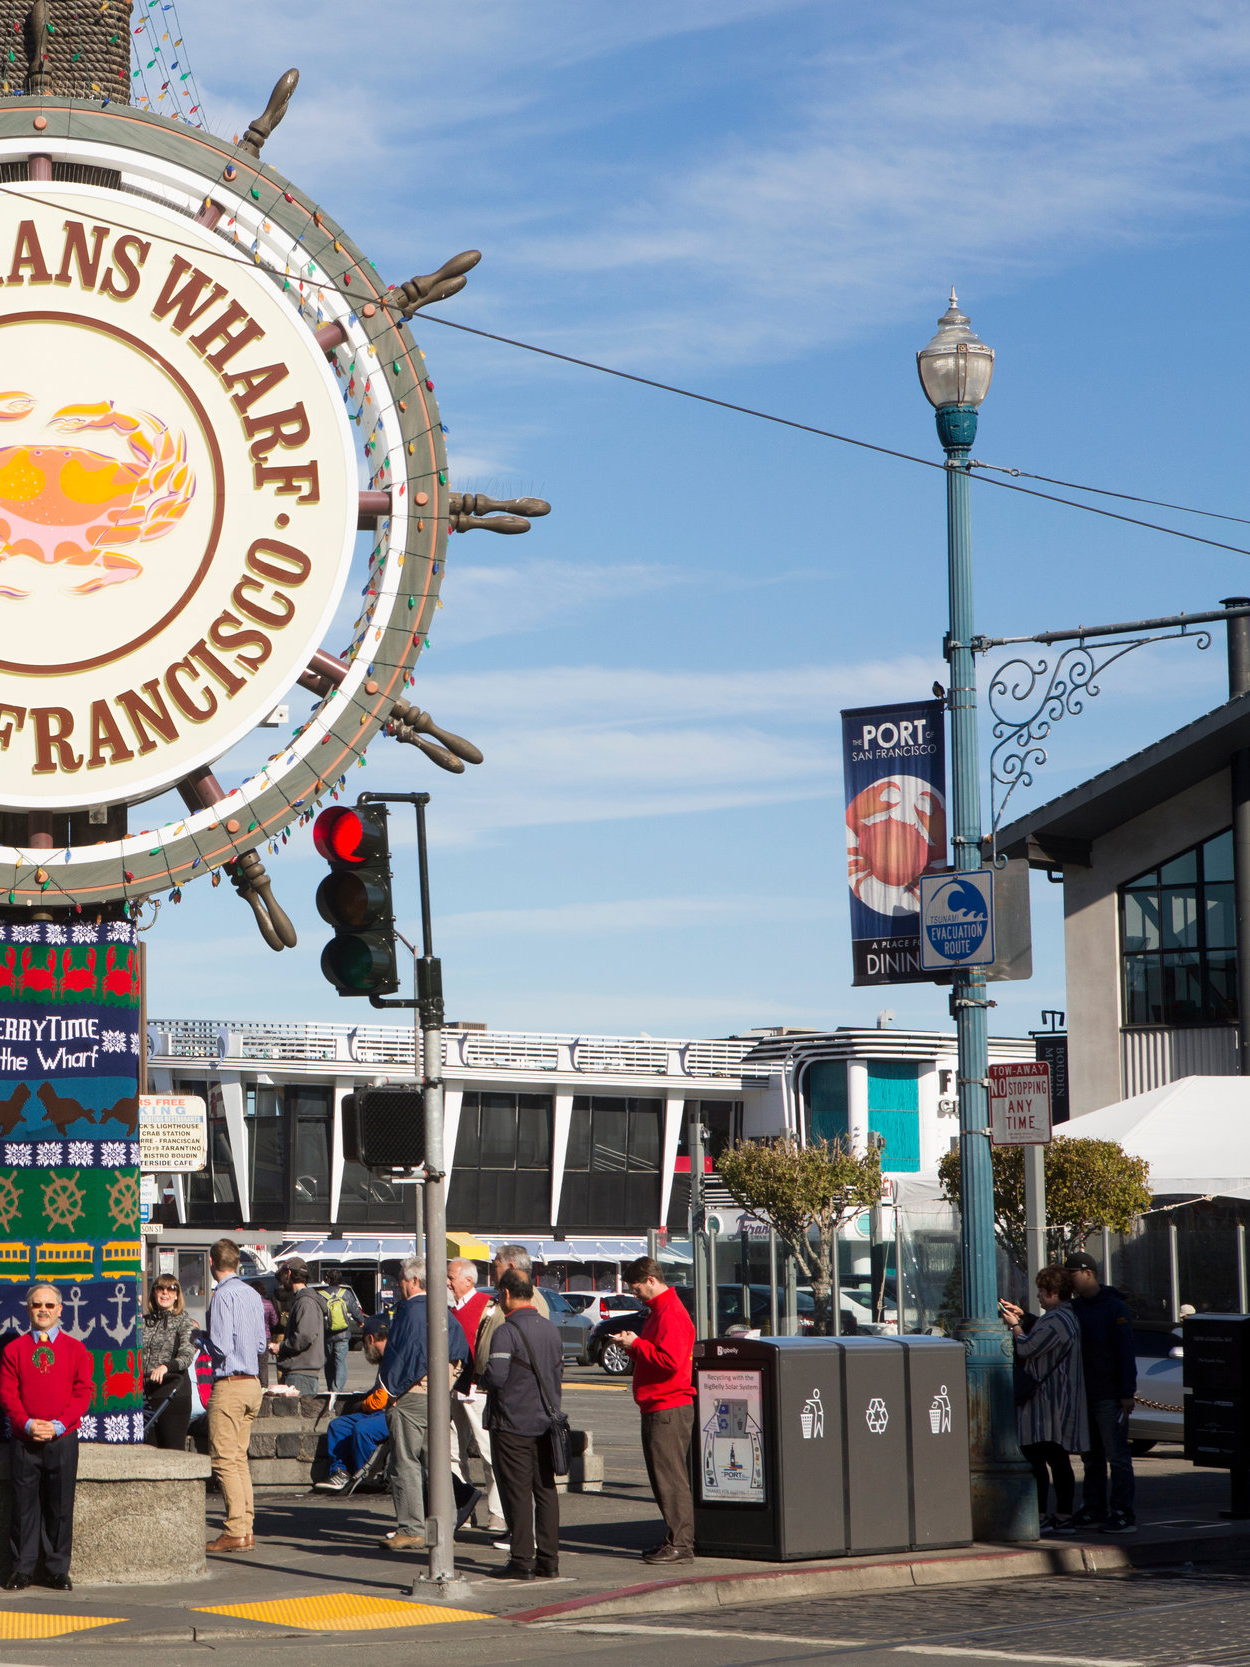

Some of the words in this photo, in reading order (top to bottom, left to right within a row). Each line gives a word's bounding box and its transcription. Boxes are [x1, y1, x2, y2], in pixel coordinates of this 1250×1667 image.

[151, 255, 320, 504] WHARF
[852, 738, 862, 746] THE
[862, 720, 926, 749] PORT
[852, 750, 875, 762] SAN
[876, 743, 937, 759] FRANCISCO
[930, 914, 959, 924] TSUNAMI
[931, 923, 983, 941] EVACUATION
[882, 939, 909, 949] PLACE
[944, 940, 971, 955] ROUTE
[866, 951, 920, 975] DININ
[0, 1047, 28, 1071] the
[36, 1045, 99, 1071] Wharf
[992, 1064, 1045, 1076] TOW-AWAY
[1056, 1047, 1065, 1097] BOUDIN
[990, 1078, 1007, 1097] NO
[1008, 1080, 1047, 1096] STOPPING
[139, 1098, 152, 1106] RS
[156, 1098, 186, 1106] FREE
[1007, 1099, 1032, 1114] ANY
[139, 1106, 186, 1115] KING
[1005, 1115, 1035, 1130] TIME
[141, 1224, 154, 1232] SON
[155, 1224, 162, 1232] ST
[707, 1374, 732, 1382] Recycling
[703, 1383, 724, 1392] BigBelly
[739, 1384, 759, 1392] System
